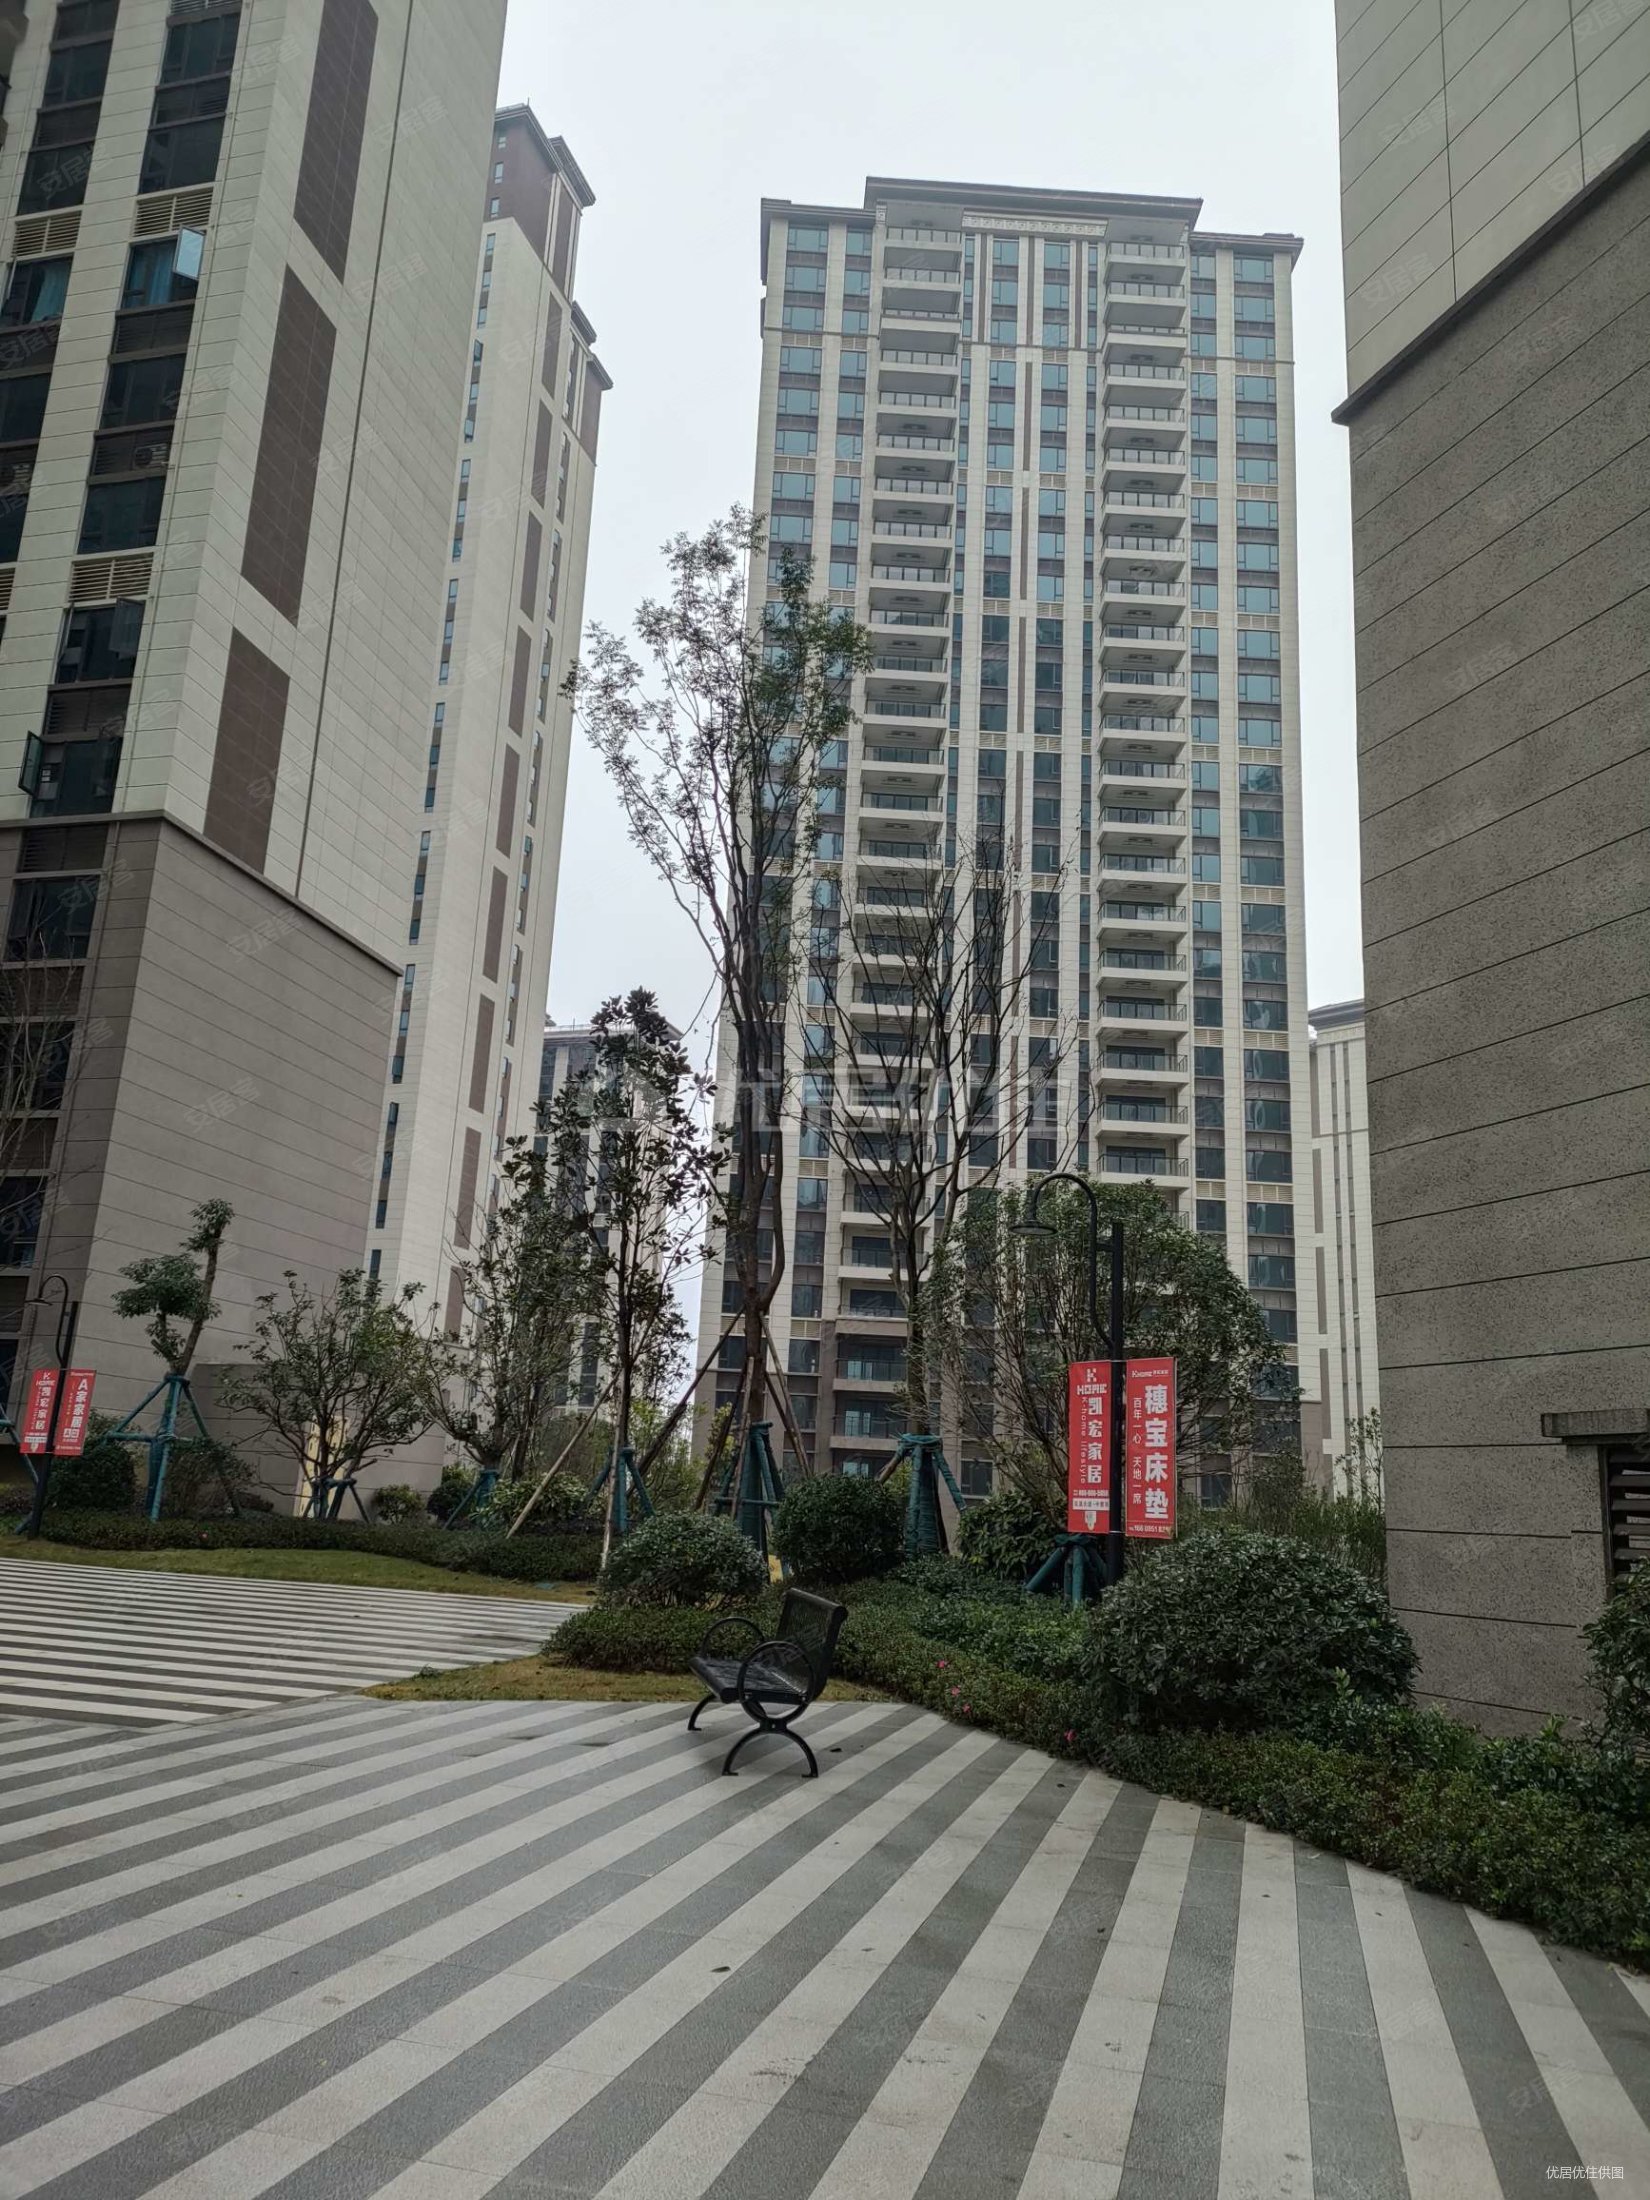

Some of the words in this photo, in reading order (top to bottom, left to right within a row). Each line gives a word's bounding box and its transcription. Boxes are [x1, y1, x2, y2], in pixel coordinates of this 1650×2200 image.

[1087, 1397, 1102, 1484] 凯宏家居
[1132, 1397, 1142, 1445] 百年一心
[1144, 1384, 1169, 1520] 穗宝床垫
[1132, 1456, 1142, 1504] 天地一席
